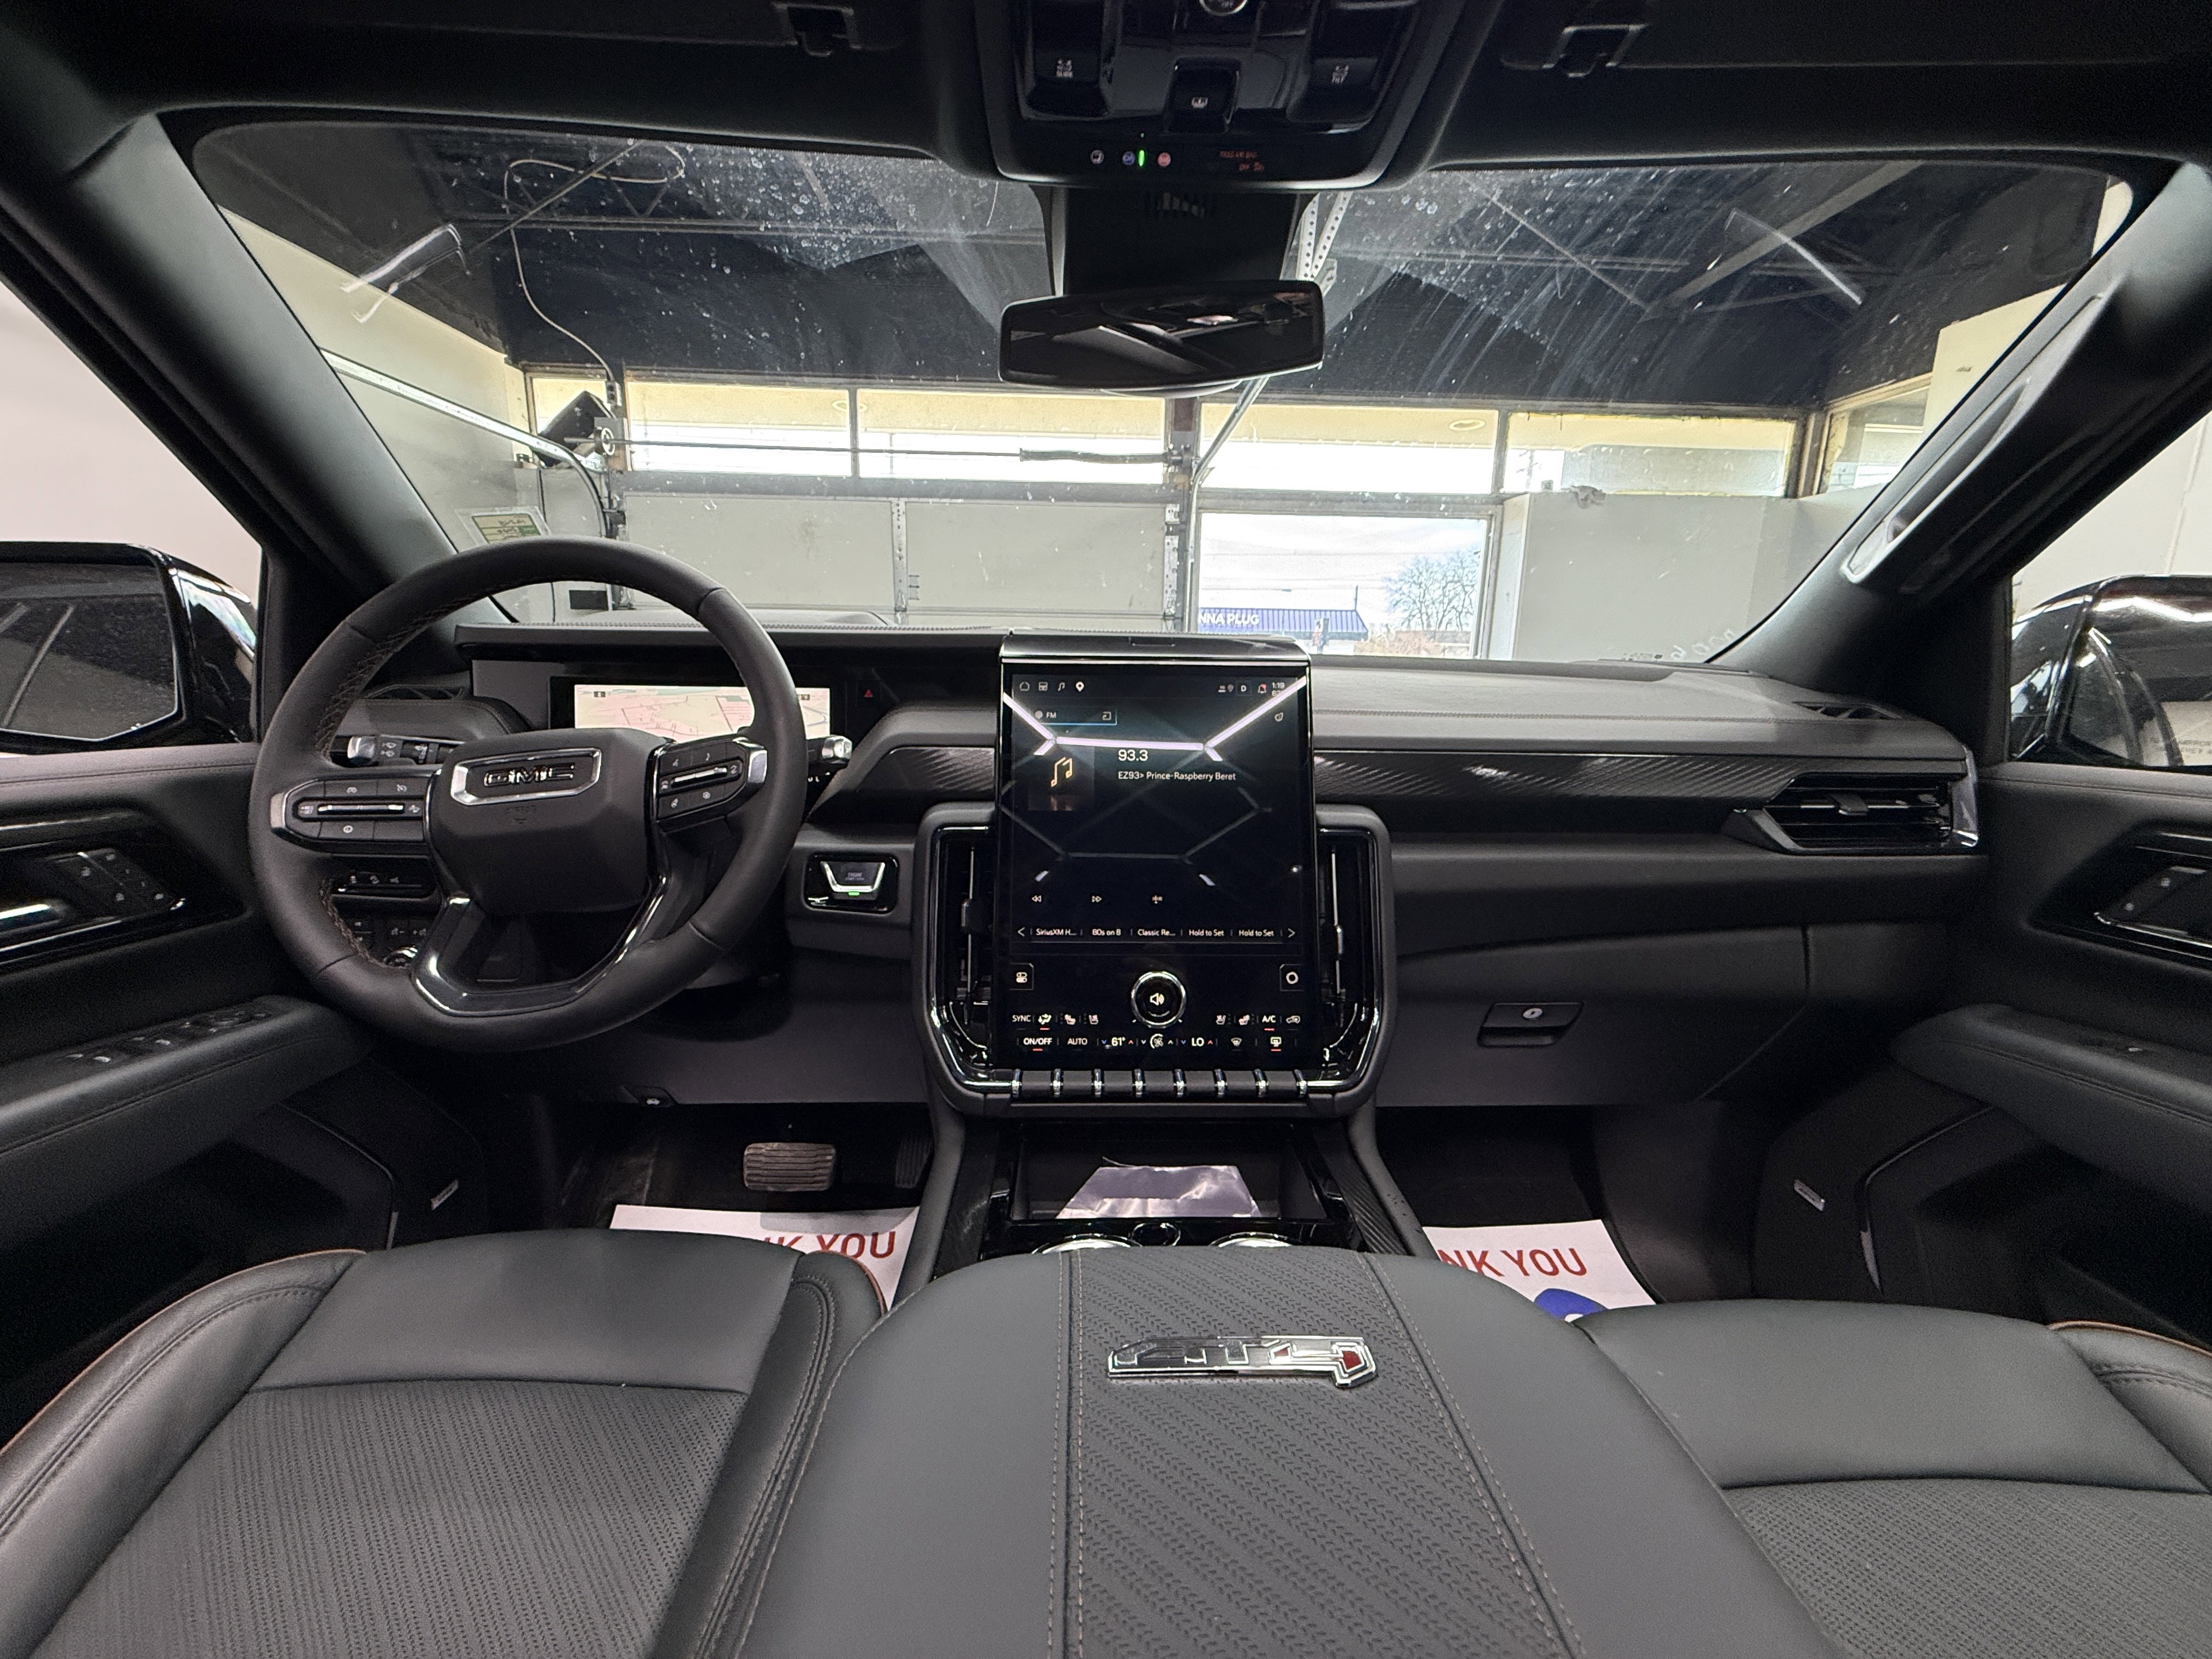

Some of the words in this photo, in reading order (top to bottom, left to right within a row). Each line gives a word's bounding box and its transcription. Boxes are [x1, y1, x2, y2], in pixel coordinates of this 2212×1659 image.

[1227, 613, 1260, 625] PLUG
[1118, 749, 1149, 761] 93.3
[483, 764, 575, 787] GMC
[1146, 771, 1213, 782] Prince-Raspberry
[1215, 771, 1237, 781] Beret
[1137, 928, 1160, 936] Classic
[1263, 929, 1274, 937] Set
[1012, 1014, 1031, 1023] SYNC
[1262, 1014, 1276, 1023] A/C
[1023, 1037, 1052, 1046] ON/OFF
[1066, 1037, 1088, 1046] AUTO
[1191, 1037, 1205, 1047] LO
[816, 1231, 896, 1259] YOU
[1500, 1248, 1587, 1277] YOU
